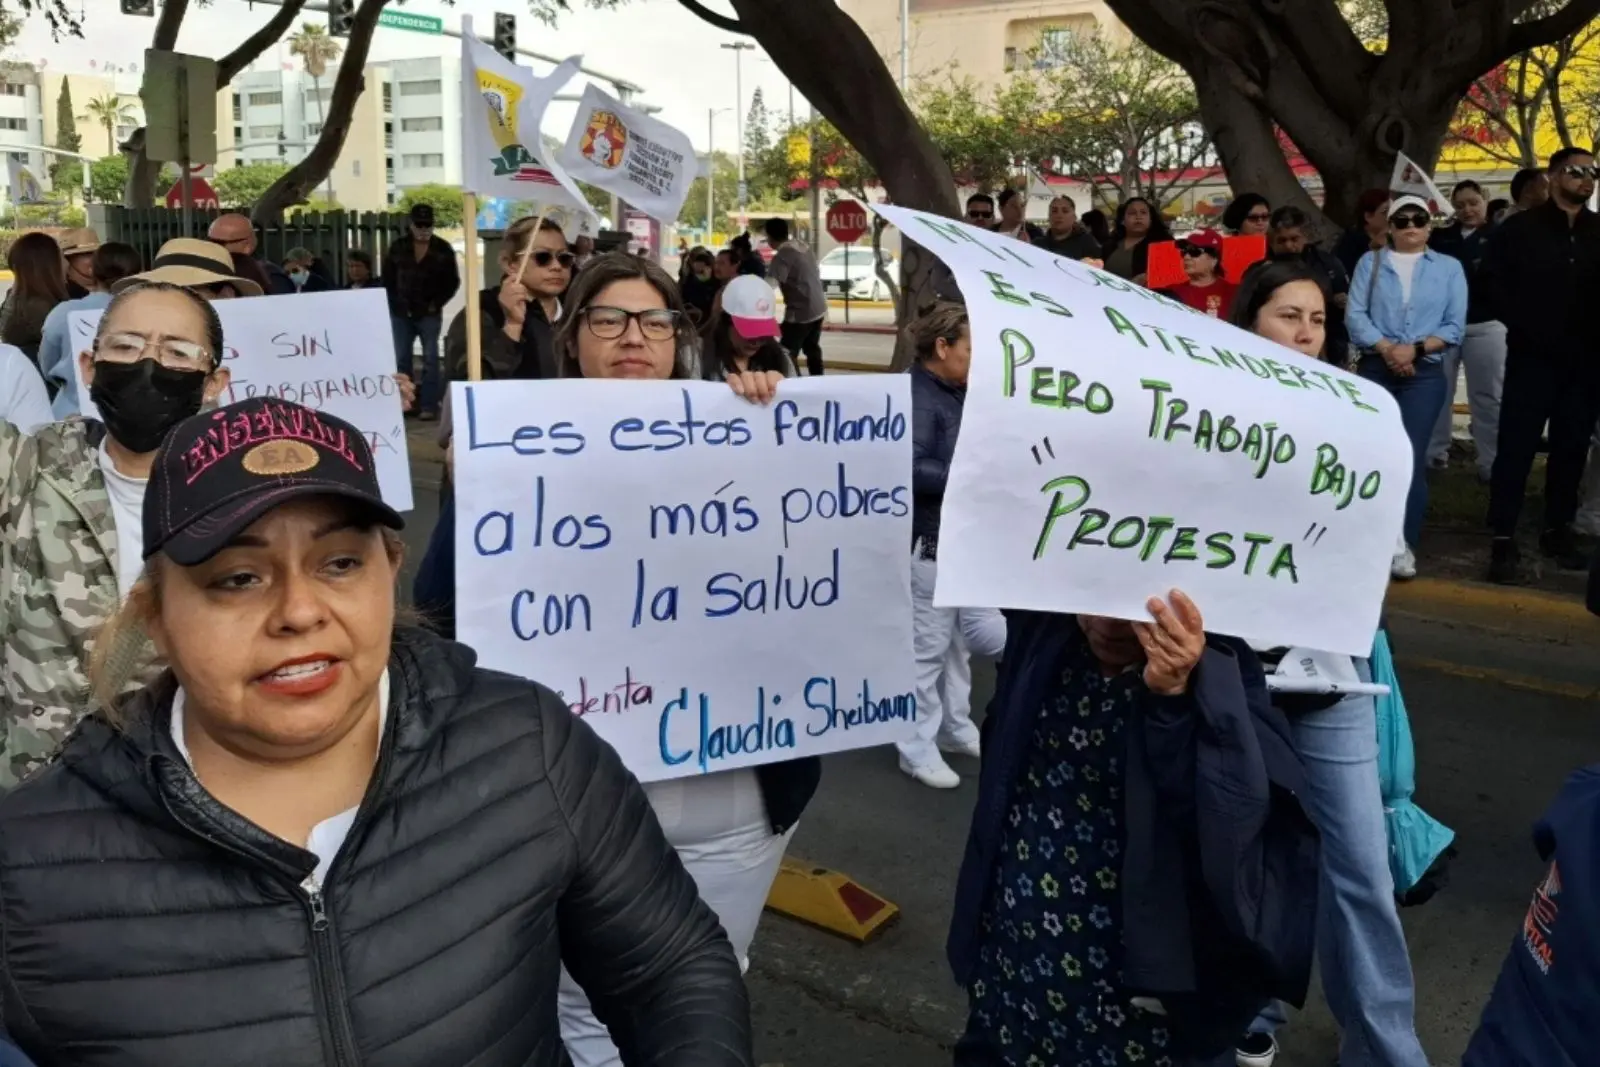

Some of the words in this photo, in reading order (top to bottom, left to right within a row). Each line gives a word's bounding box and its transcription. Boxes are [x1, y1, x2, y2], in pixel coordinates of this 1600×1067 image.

[829, 212, 866, 230] ALTO
[271, 329, 333, 360] SIN
[980, 269, 1073, 319] ES
[1102, 305, 1381, 413] ATENDERTE
[259, 447, 306, 469] EA
[465, 386, 586, 456] Les
[774, 393, 906, 446] fallando
[1000, 327, 1115, 414] PERO
[1140, 378, 1297, 480] TRABAJO
[1310, 442, 1382, 511] BAJO
[650, 480, 760, 540] más
[781, 462, 910, 549] pobres
[511, 589, 592, 641] con
[631, 558, 679, 629] la
[558, 666, 653, 717] denta
[658, 686, 796, 775] Claudia
